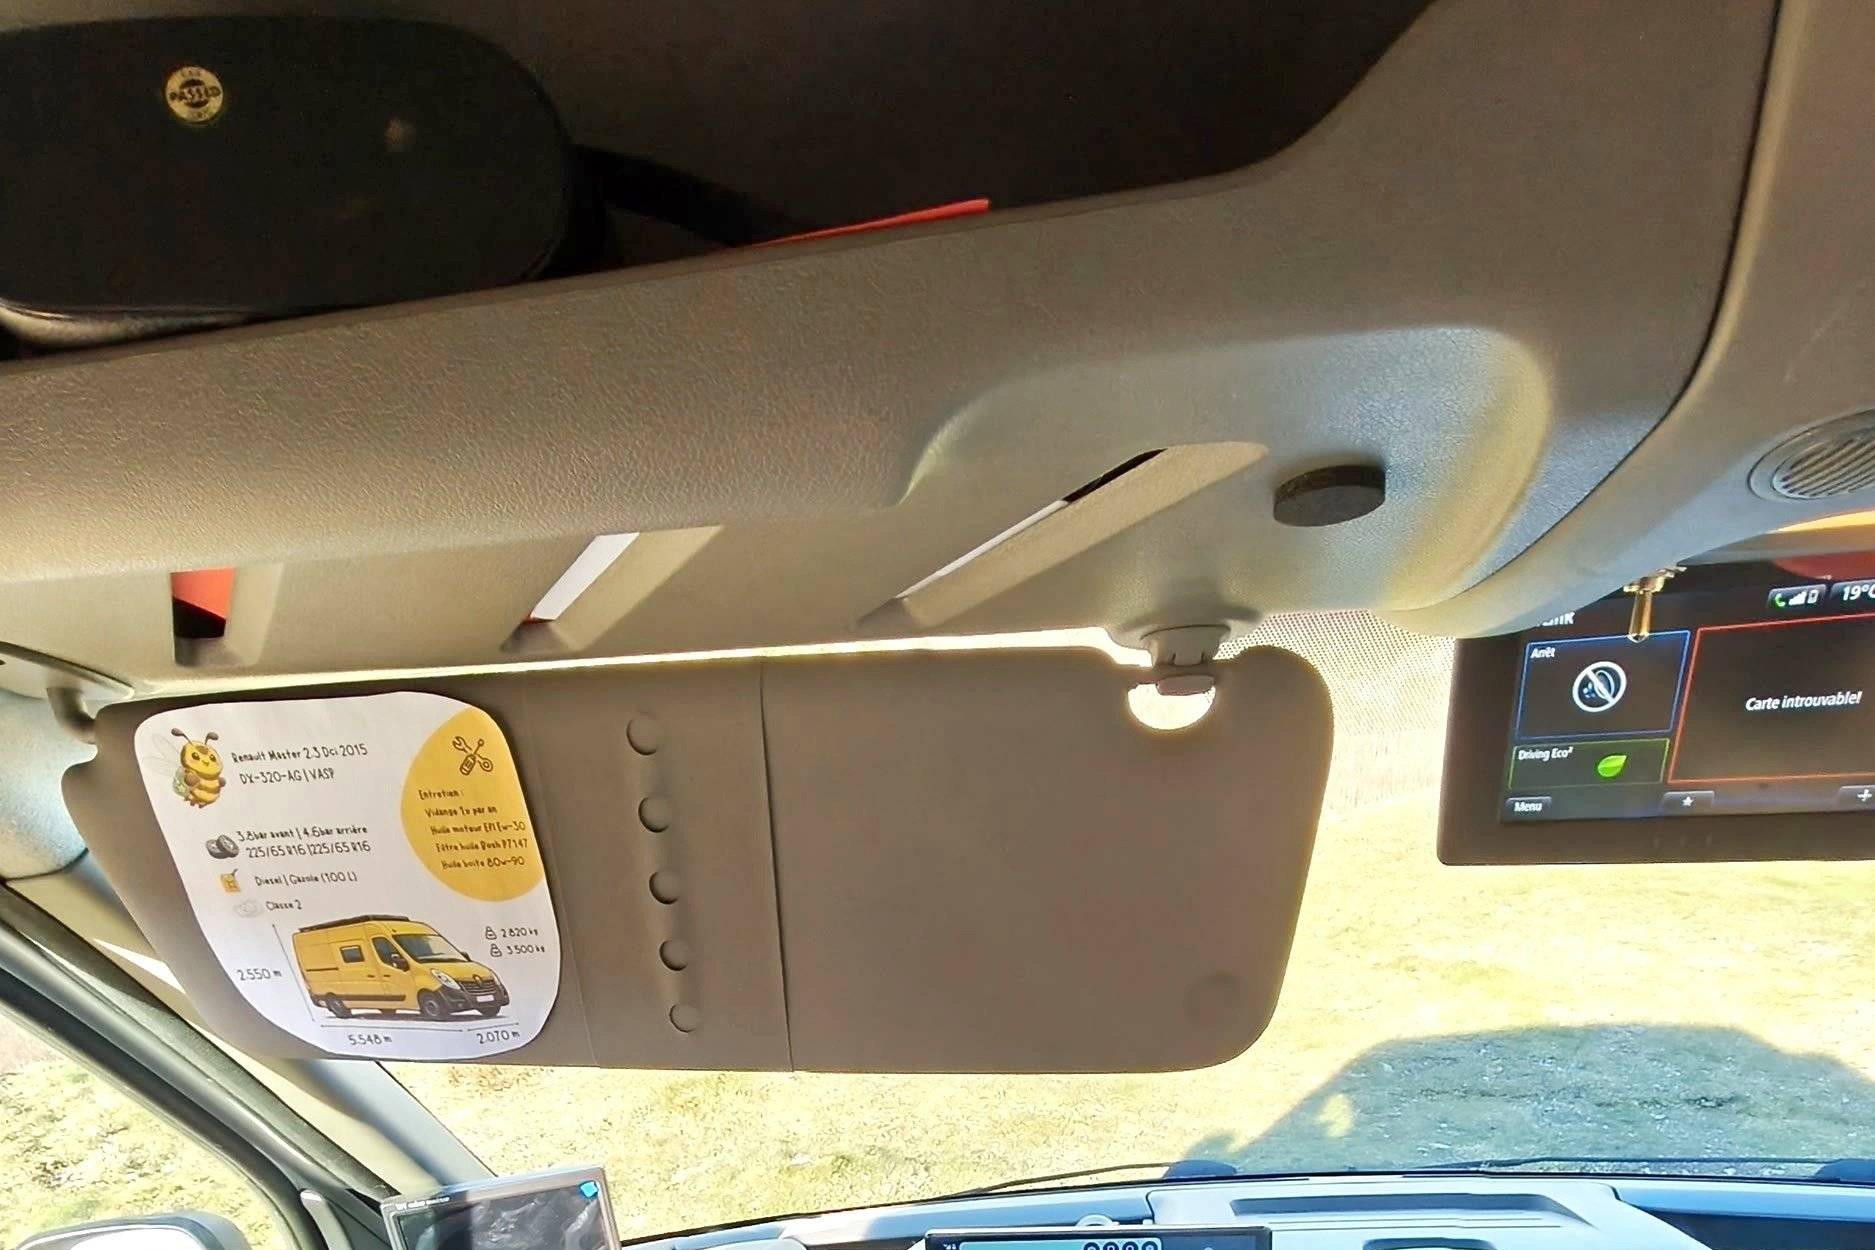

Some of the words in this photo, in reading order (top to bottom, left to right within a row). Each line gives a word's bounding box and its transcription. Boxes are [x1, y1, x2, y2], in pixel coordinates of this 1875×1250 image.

[1531, 646, 1556, 659] Arrêt
[1745, 697, 1780, 711] Carte
[1781, 691, 1862, 708] introuvable!
[231, 752, 266, 763] Renault
[269, 750, 301, 761] Master
[339, 743, 368, 757] 2015
[1518, 749, 1550, 762] Driving
[309, 768, 335, 780] VASP
[424, 808, 458, 818] Vidange
[473, 806, 485, 816] par
[487, 806, 498, 814] an
[1514, 801, 1543, 812] Menu
[270, 829, 295, 839] avant
[452, 824, 482, 833] moteur
[246, 845, 286, 858] 225/65
[255, 875, 282, 887] Diesel
[266, 900, 293, 911] Classe
[294, 899, 303, 910] 2
